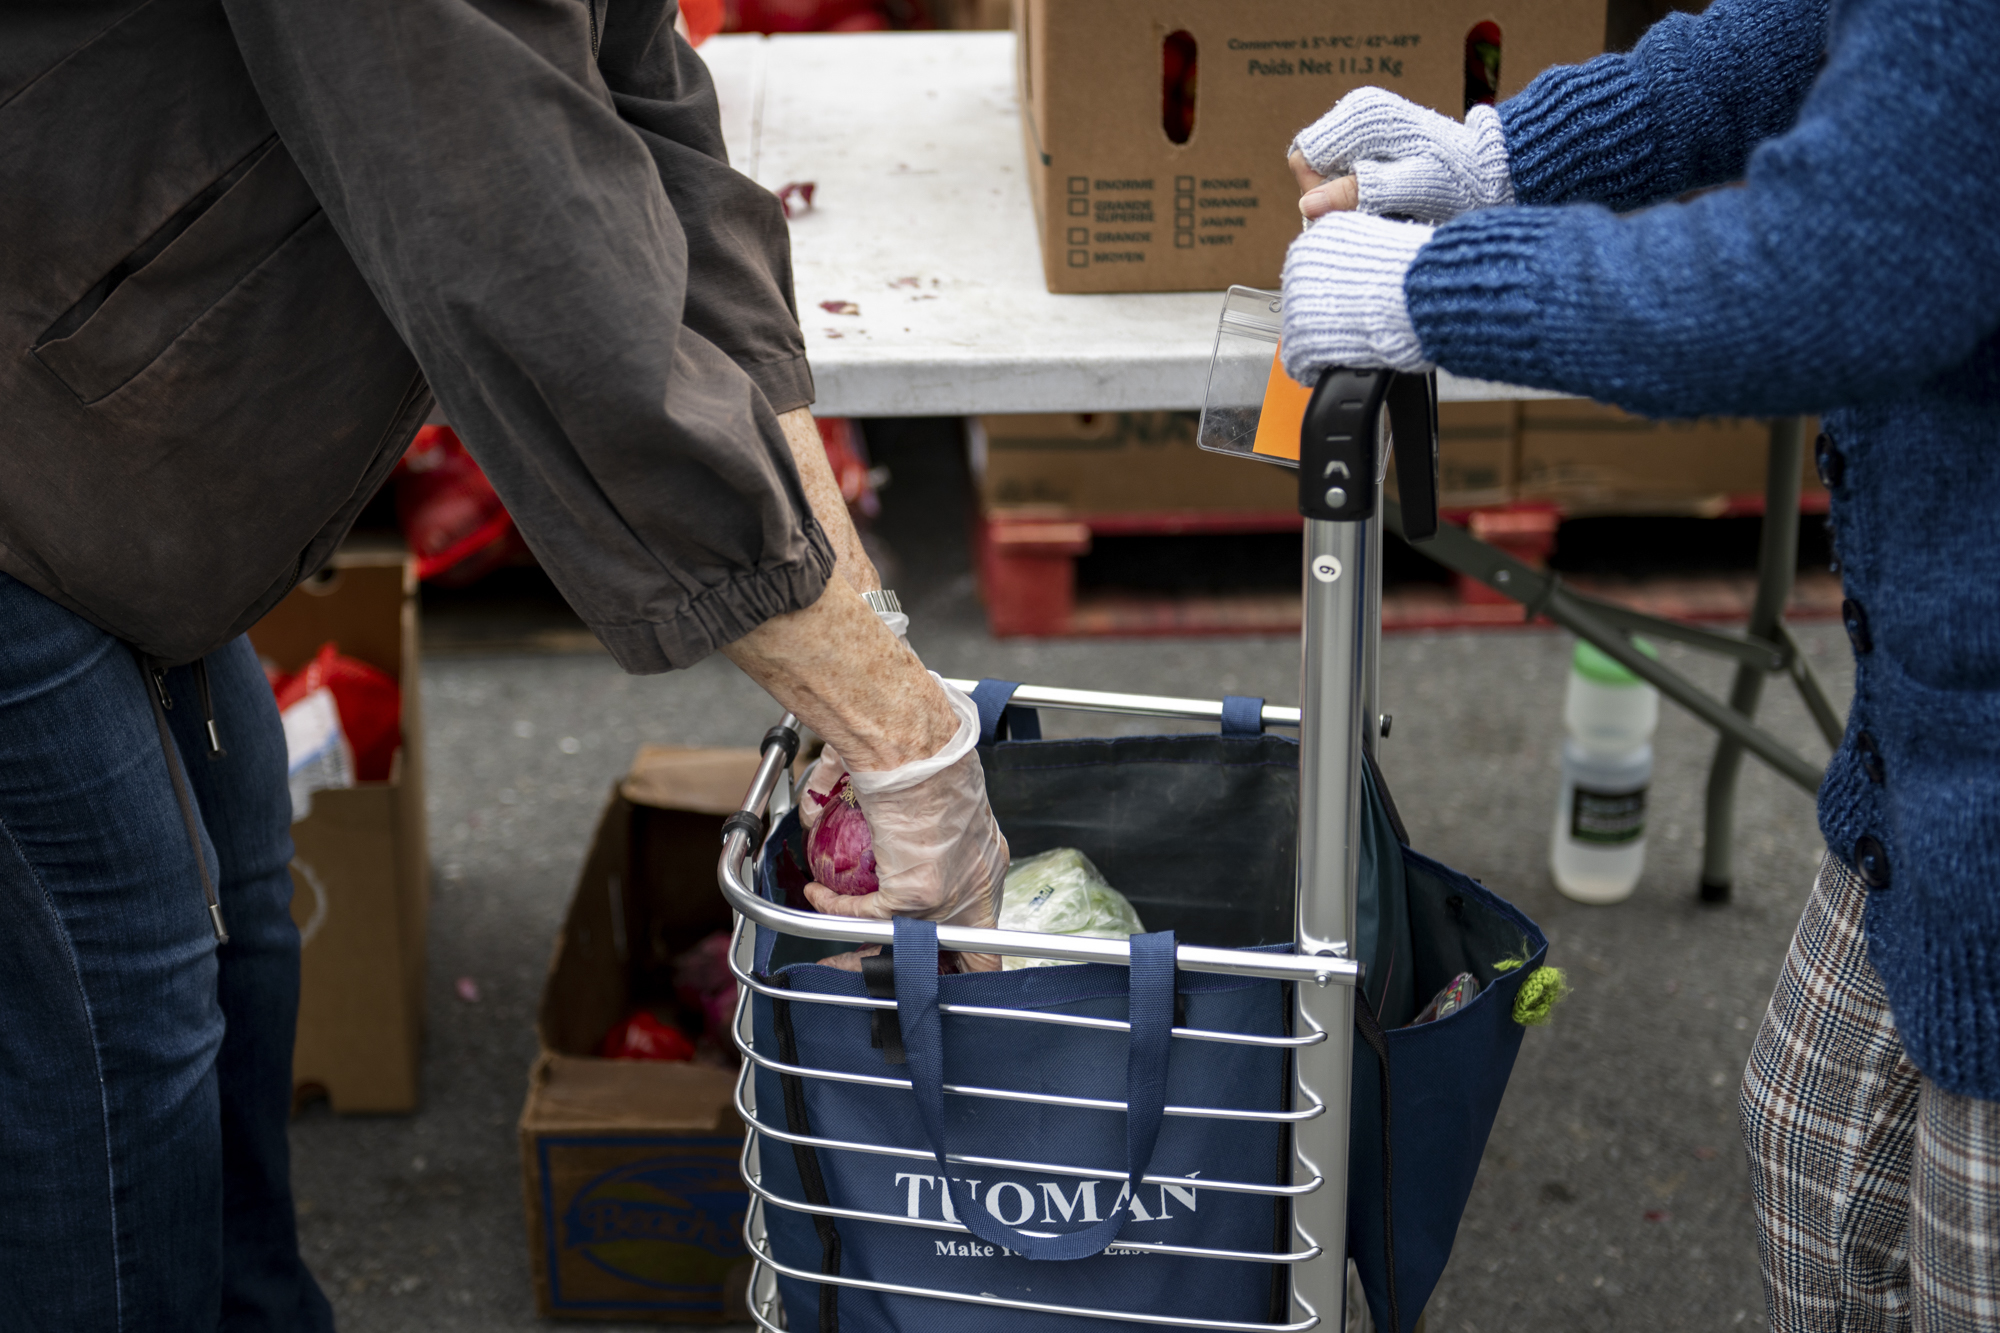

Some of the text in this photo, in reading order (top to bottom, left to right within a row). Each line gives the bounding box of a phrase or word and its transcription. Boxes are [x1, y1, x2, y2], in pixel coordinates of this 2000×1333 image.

[1248, 55, 1404, 78] Poids Net 11.3 Kg
[1200, 178, 1252, 190] ROUGE
[1198, 197, 1259, 209] ORANGE
[1200, 217, 1247, 228] JAUNE
[1094, 232, 1153, 243] GRANDE
[1199, 234, 1235, 246] VERT
[934, 1240, 995, 1257] Make
